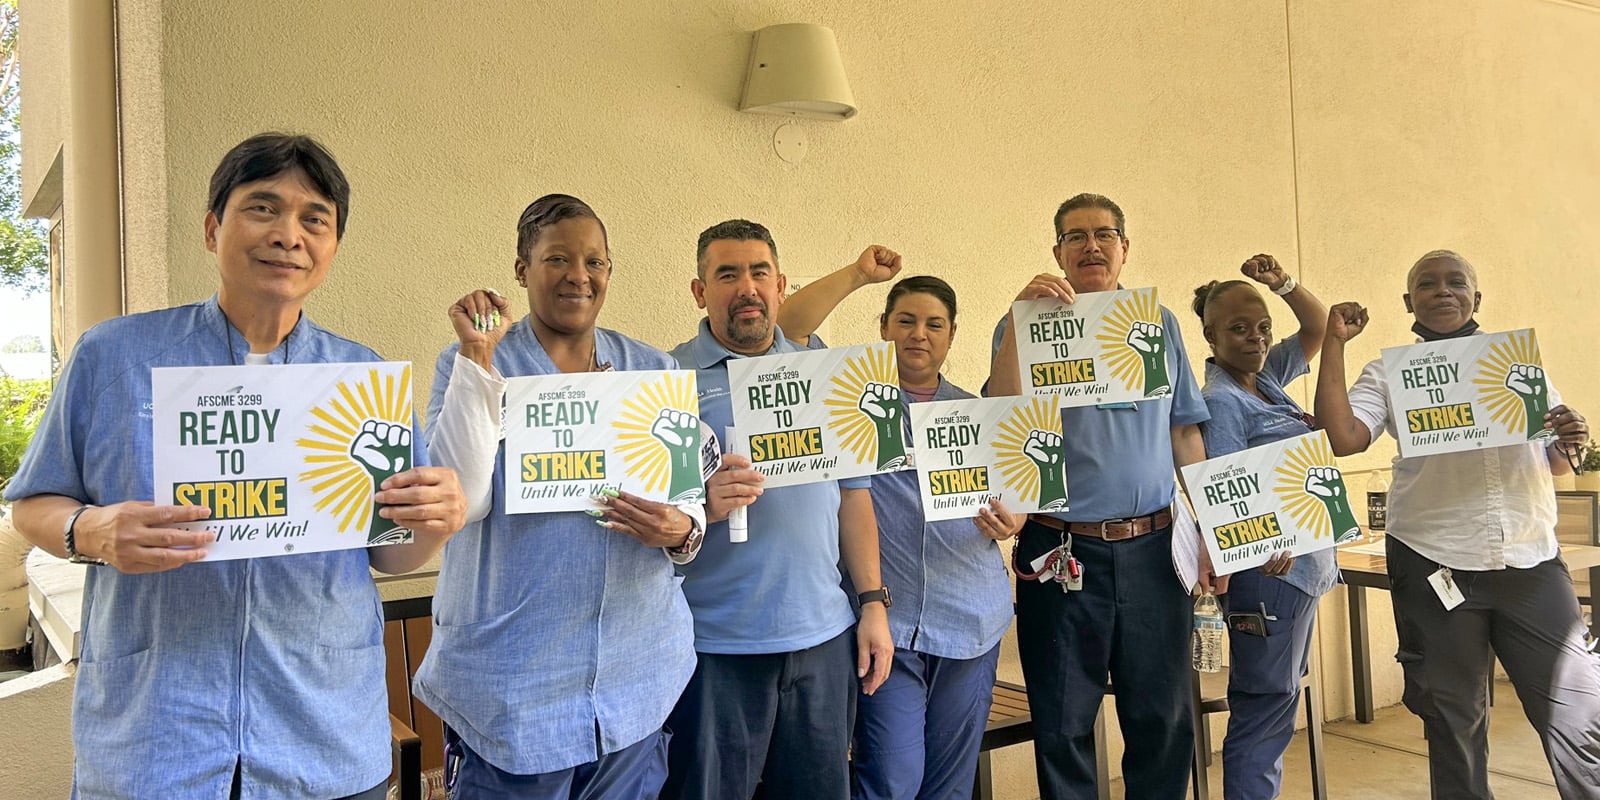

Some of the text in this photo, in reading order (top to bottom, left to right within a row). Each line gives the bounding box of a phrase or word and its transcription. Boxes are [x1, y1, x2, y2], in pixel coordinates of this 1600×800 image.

[1038, 310, 1074, 320] AFSCME 3299
[1030, 318, 1085, 343] READY
[1051, 343, 1069, 359] TO
[1409, 355, 1447, 366] AFSCME 3299
[757, 370, 800, 382] AFSCME 3299
[1032, 359, 1095, 386] STRIKE
[1401, 362, 1459, 389] READY
[197, 394, 262, 407] AFSCME 3299
[538, 389, 586, 401] AFSCME 3299
[748, 379, 812, 410] READY
[1064, 386, 1081, 397] We
[1083, 383, 1109, 395] Win!
[1426, 388, 1445, 404] TO
[526, 400, 599, 428] READY
[773, 409, 793, 429] TO
[934, 415, 970, 424] AFSCME 3299
[1407, 403, 1474, 432] STRIKE
[179, 408, 281, 446] READY
[926, 423, 981, 449] READY
[1411, 427, 1489, 446] Until We Win!
[552, 428, 574, 449] TO
[750, 428, 822, 462] STRIKE
[216, 448, 244, 476] TO
[522, 450, 605, 482] STRIKE
[787, 460, 807, 473] We
[809, 455, 838, 470] Win!
[947, 449, 964, 466] TO
[930, 467, 988, 495] STRIKE
[1210, 466, 1247, 482] AFSCME 3299
[175, 479, 286, 519] STRIKE
[521, 485, 559, 500] Until
[562, 484, 585, 497] We
[1203, 472, 1261, 506] READY
[933, 496, 958, 510] Until
[960, 495, 976, 507] We
[1230, 500, 1250, 518] TO
[229, 524, 259, 541] We
[265, 520, 309, 540] Win!
[1215, 513, 1281, 549] STRIKE
[1223, 534, 1297, 564] Until We Win!
